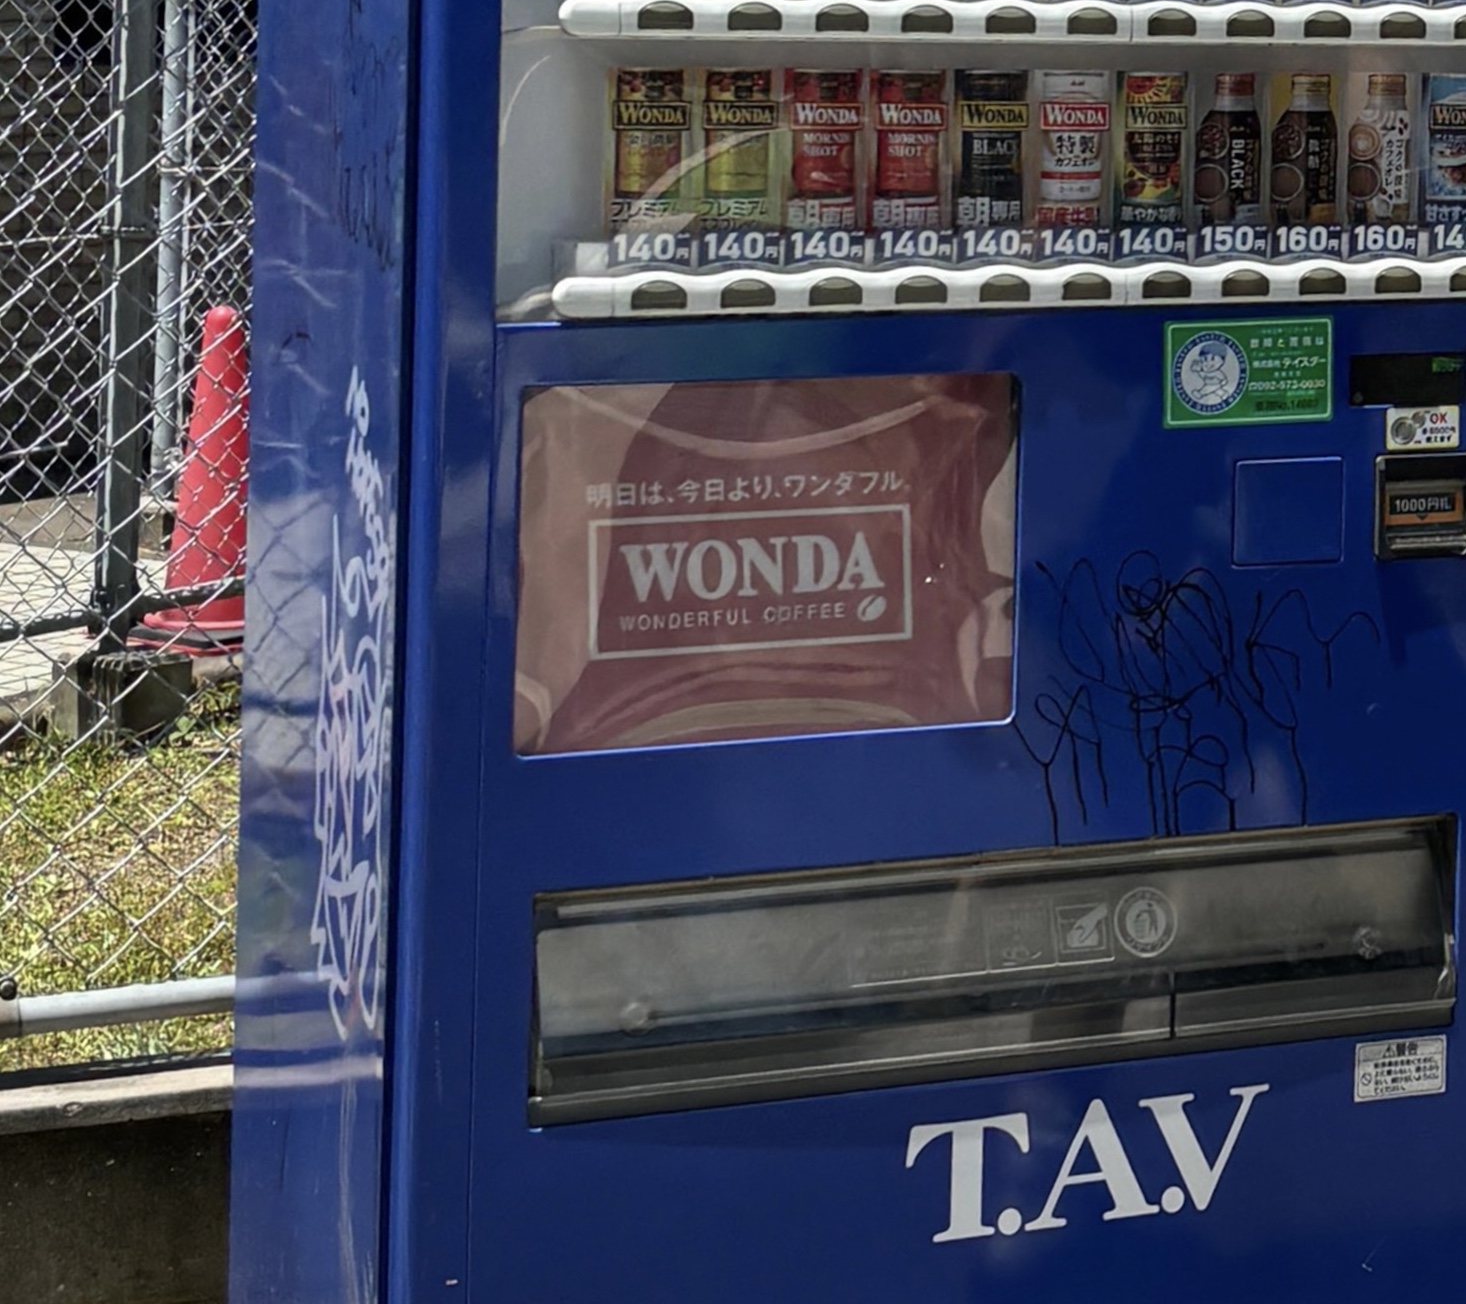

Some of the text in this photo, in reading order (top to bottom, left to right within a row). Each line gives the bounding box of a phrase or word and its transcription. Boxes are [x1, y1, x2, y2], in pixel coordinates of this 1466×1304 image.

[619, 102, 684, 124] WONDA
[706, 102, 772, 124] WONDA
[796, 102, 858, 124] WONDA
[881, 102, 942, 124] WONDA
[966, 103, 1025, 124] WONDA
[1044, 104, 1104, 124] WONDA
[1130, 107, 1184, 125] WONDA
[802, 146, 838, 157] SHOT
[888, 146, 922, 158] SHOT
[1231, 138, 1245, 189] BLACK
[613, 232, 689, 261] 140円
[704, 232, 779, 259] 140円
[791, 231, 864, 258] 140円
[880, 230, 952, 258] 140円
[963, 229, 1033, 256] 140円
[1040, 228, 1109, 256] 140円
[1119, 227, 1185, 254] 140円
[1200, 226, 1266, 252] 150円
[1276, 225, 1339, 252] 160円
[1353, 224, 1416, 251] 160円
[1430, 412, 1448, 425] OK
[1395, 497, 1452, 513] 1000円札
[620, 532, 885, 603] WONDA
[620, 603, 847, 633] WONDERFUL COFFEE
[905, 1083, 1270, 1243] T.A.V
